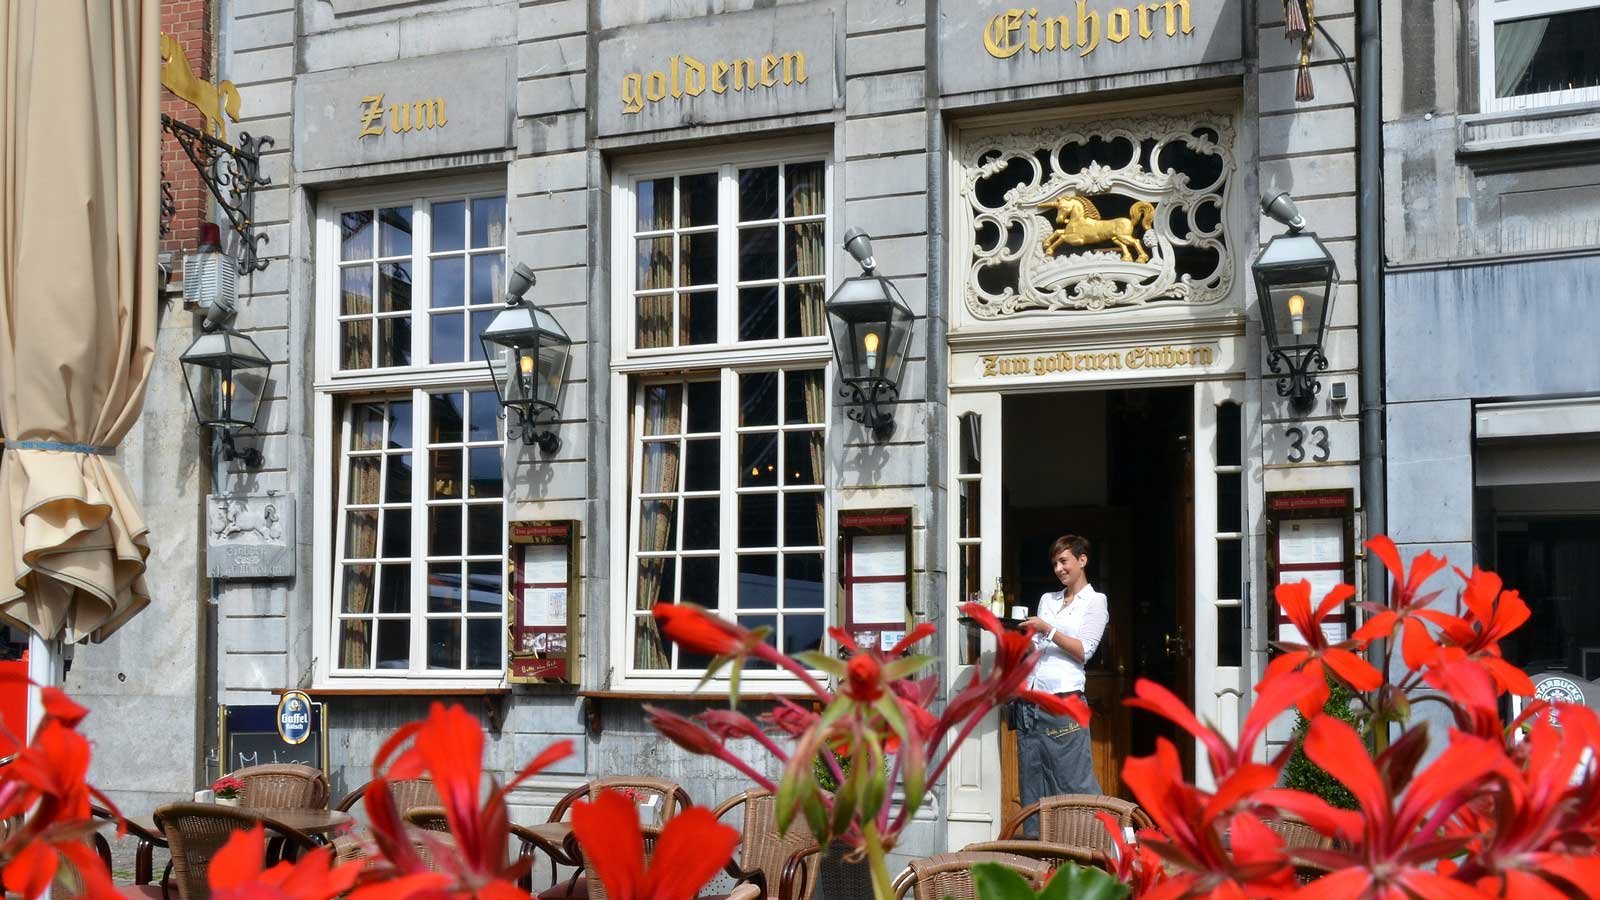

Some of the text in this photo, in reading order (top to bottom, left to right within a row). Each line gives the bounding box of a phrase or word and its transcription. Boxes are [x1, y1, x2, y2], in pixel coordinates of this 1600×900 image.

[359, 0, 1195, 139] Zum goldenen Einhorn
[983, 344, 1213, 377] Zum goldenen Einhorn
[1285, 425, 1331, 463] 33
[1535, 679, 1582, 701] STARBUCKS
[281, 713, 308, 723] Gaffel
